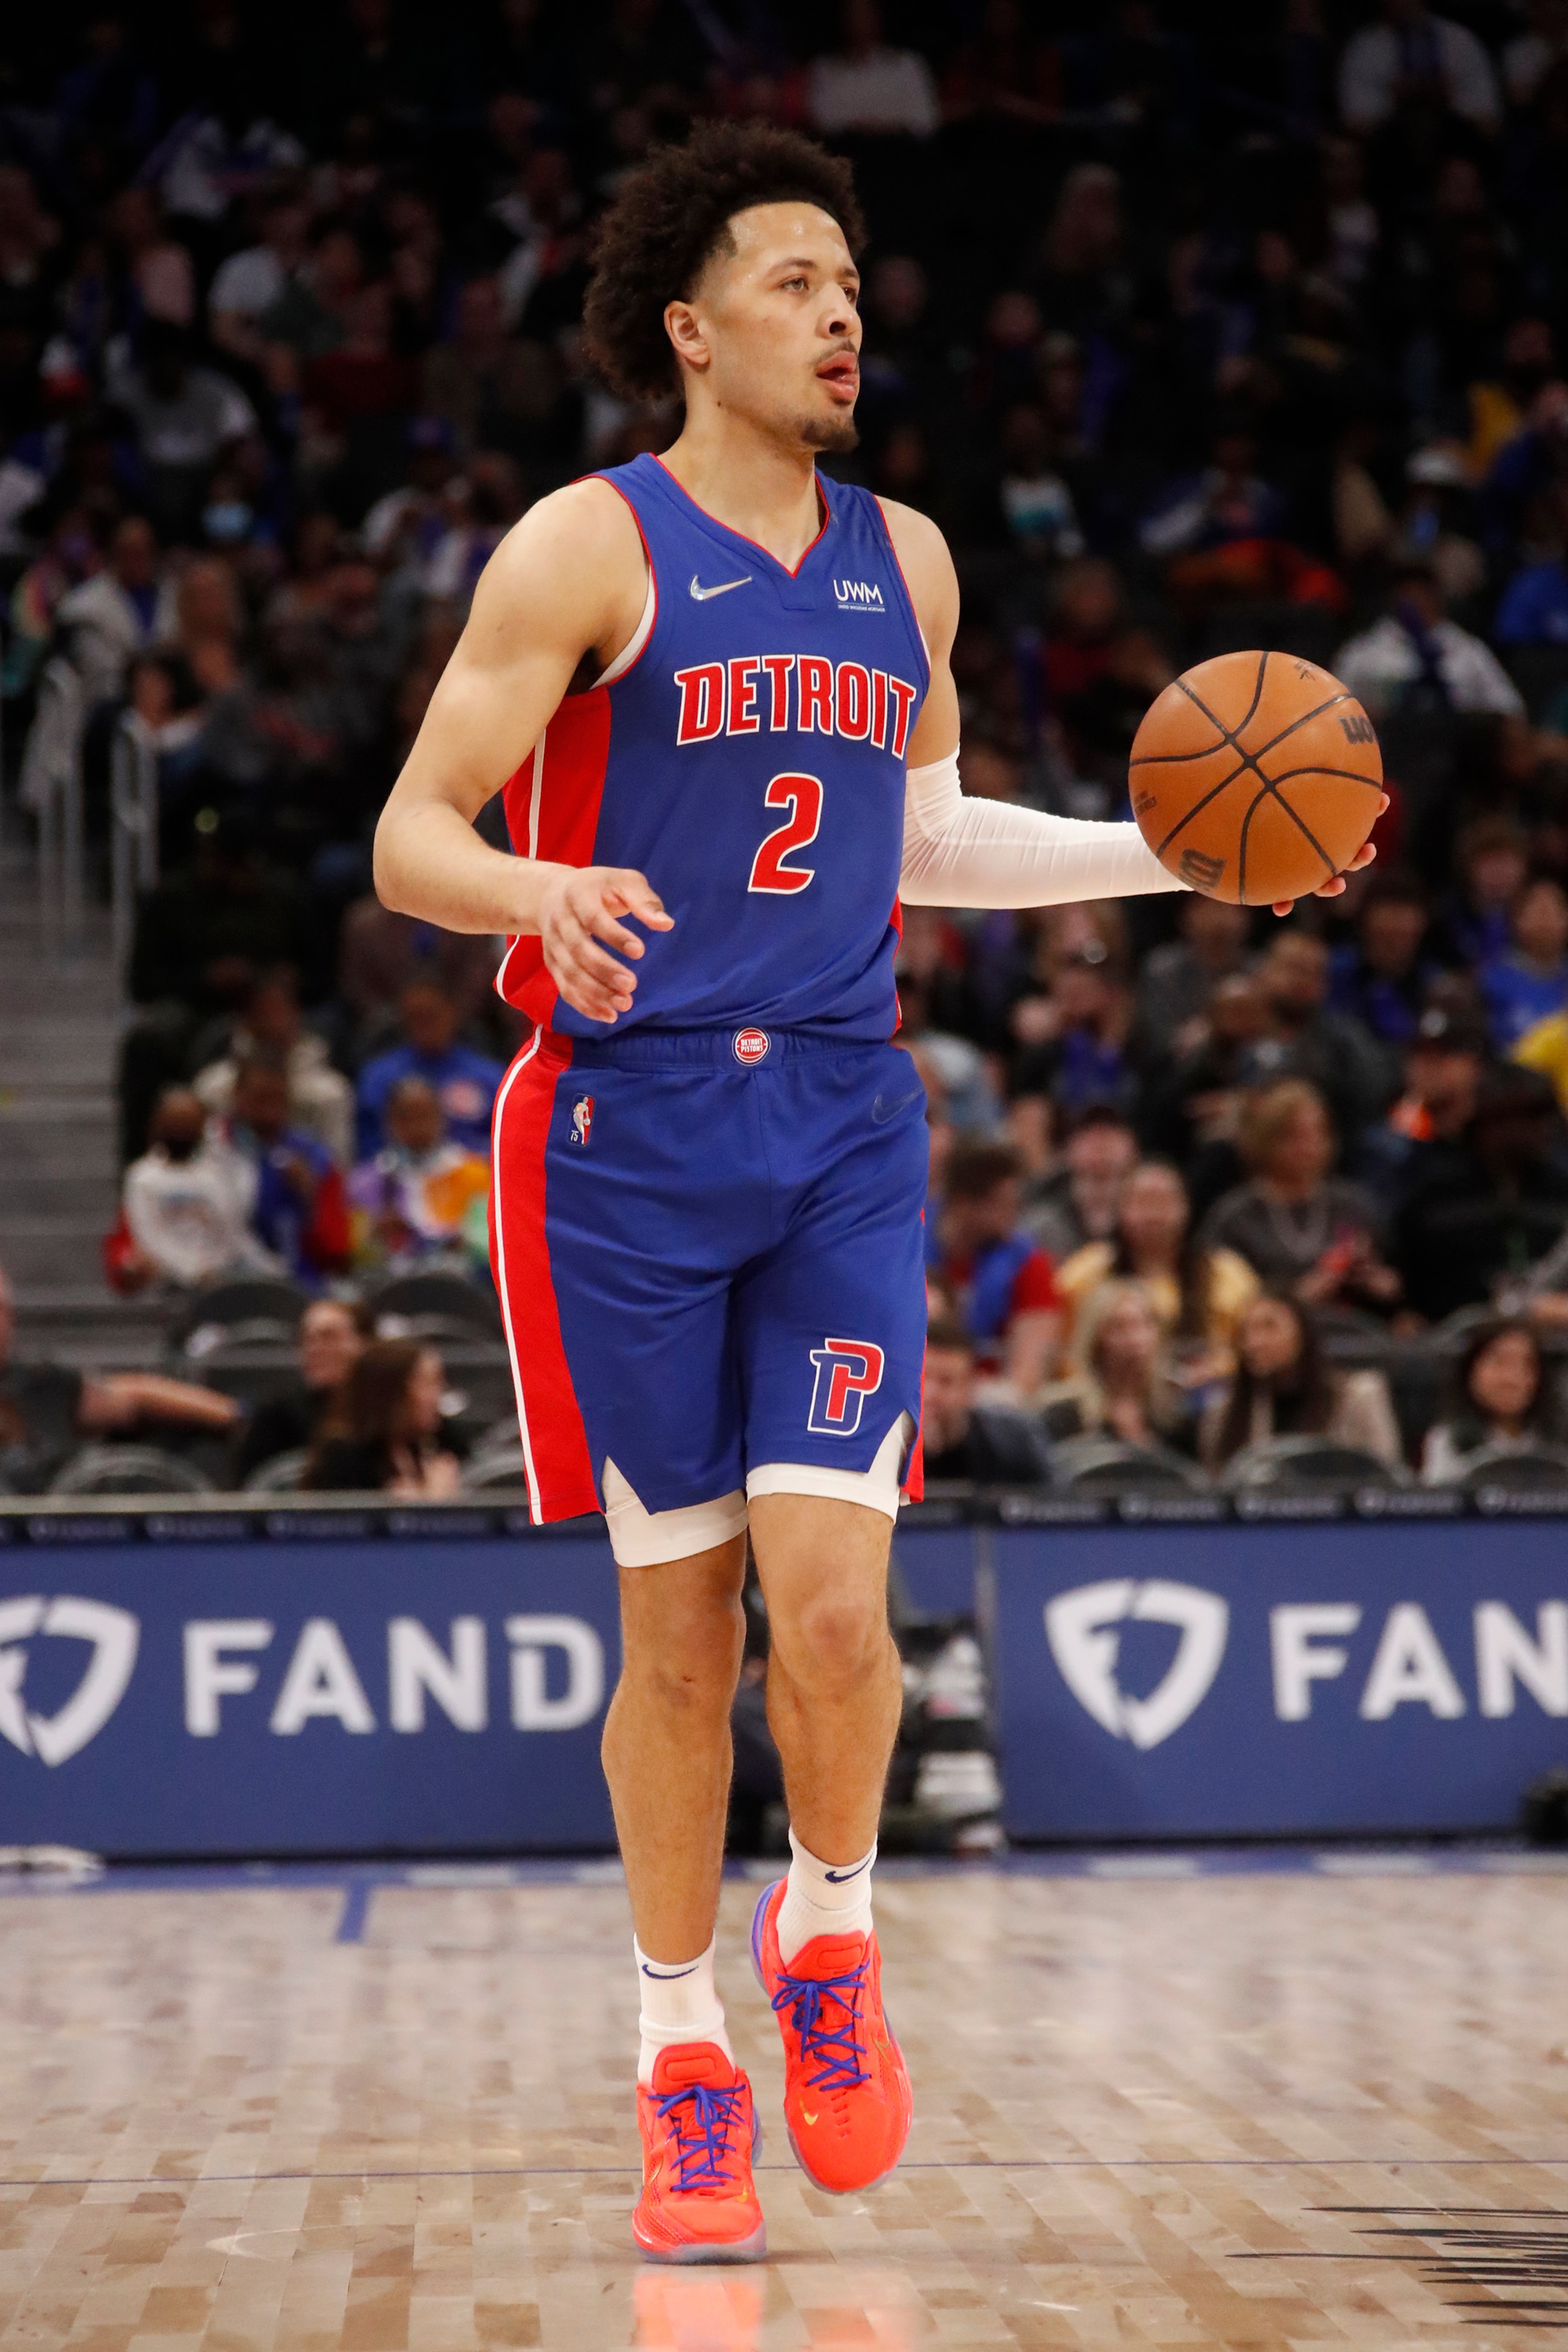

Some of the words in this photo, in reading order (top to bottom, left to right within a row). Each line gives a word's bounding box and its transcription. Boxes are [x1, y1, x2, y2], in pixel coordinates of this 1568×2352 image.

[833, 579, 883, 604] UWM
[674, 654, 917, 760] DETROIT
[747, 772, 824, 895] 2
[740, 1037, 762, 1046] DETROIT
[570, 1130, 579, 1141] 75
[183, 1614, 606, 1737] FAND
[1269, 1600, 1568, 1722] FAN
